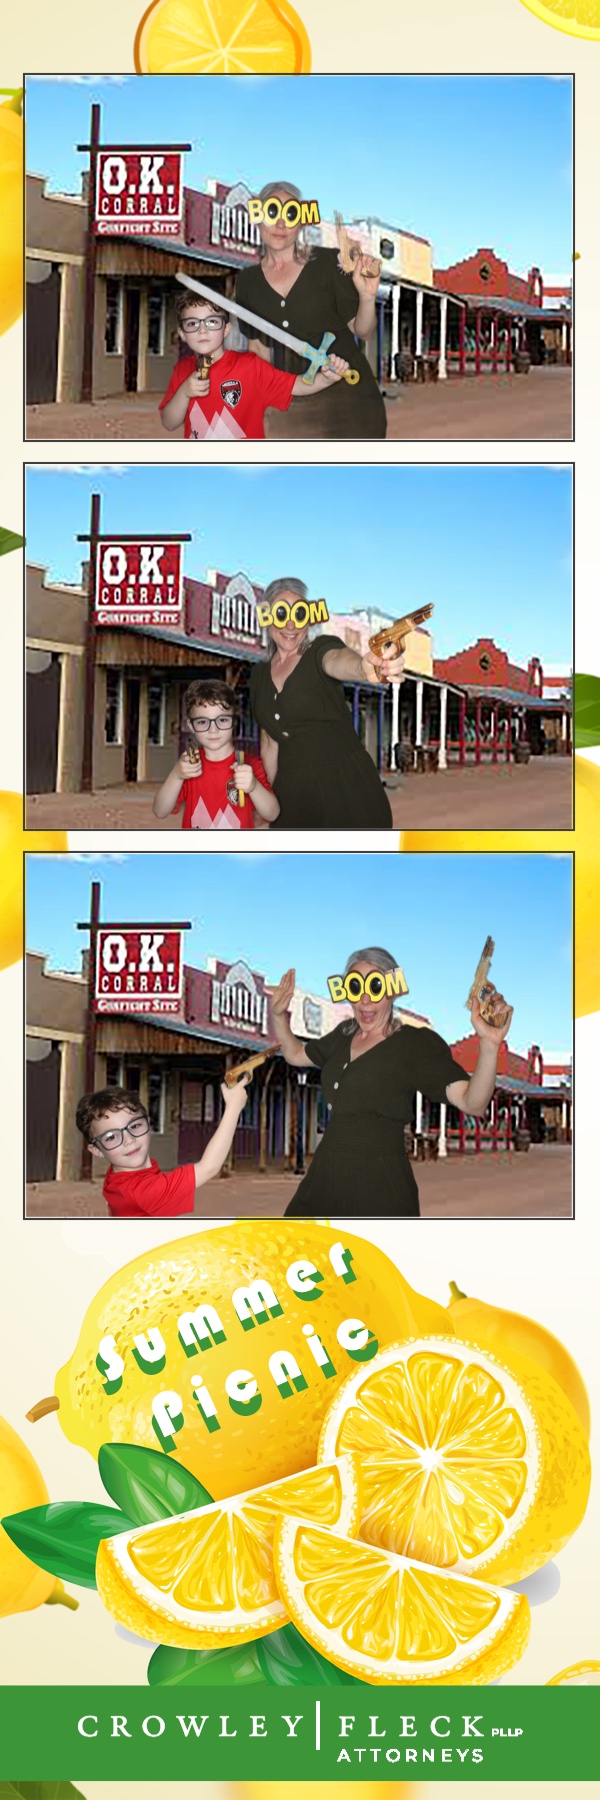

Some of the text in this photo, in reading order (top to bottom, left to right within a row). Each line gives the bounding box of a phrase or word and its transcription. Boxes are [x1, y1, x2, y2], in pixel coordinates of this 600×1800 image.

[102, 156, 175, 195] O.K.
[101, 197, 176, 214] CORRAL
[248, 196, 320, 228] BOOM
[102, 546, 175, 585] O.K.
[101, 587, 176, 604] CORRAL
[256, 599, 328, 629] BOOM
[102, 934, 175, 973] O.K.
[101, 975, 176, 992] CORRAL
[327, 967, 409, 1003] BOOM
